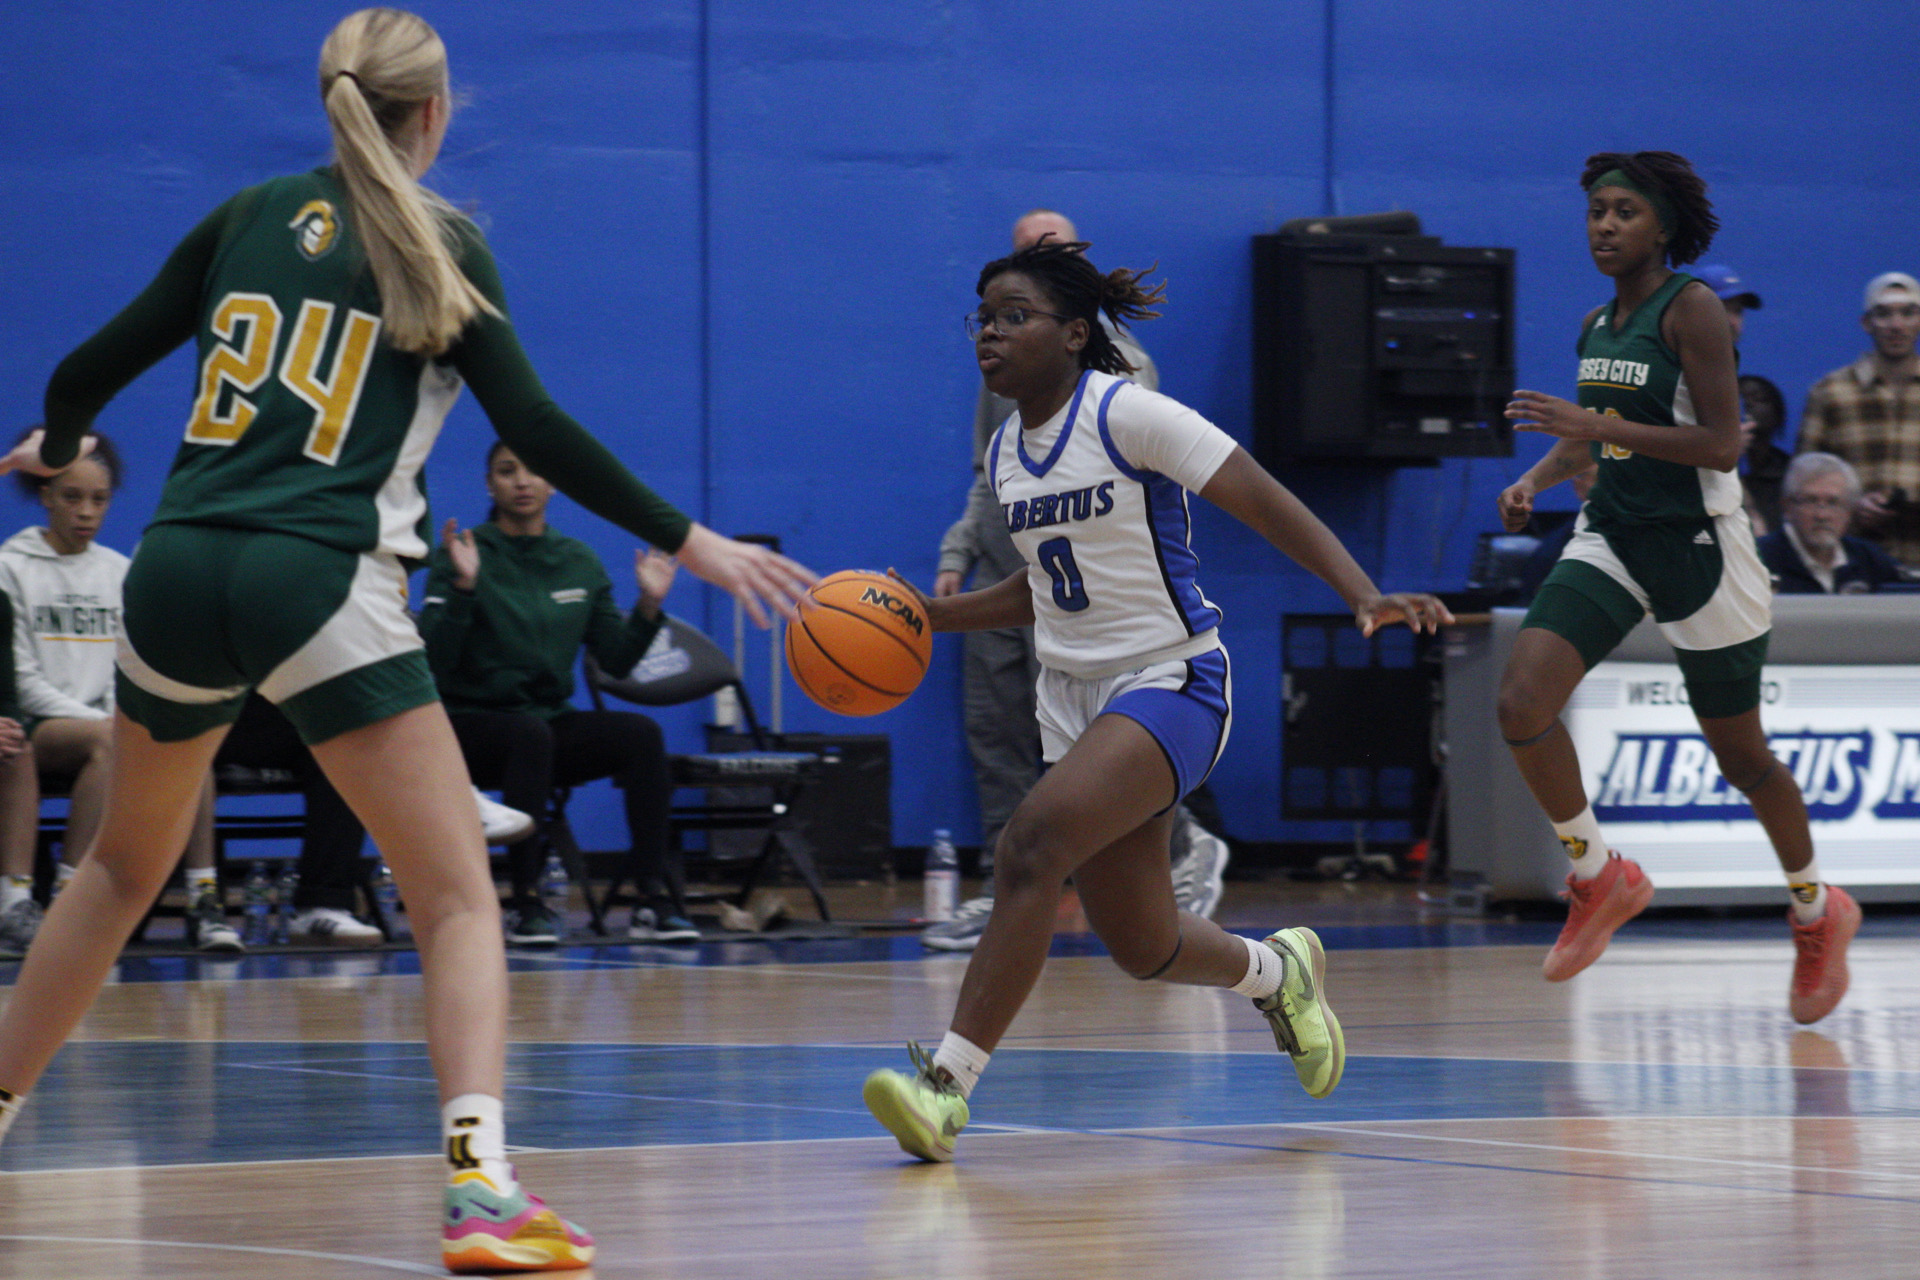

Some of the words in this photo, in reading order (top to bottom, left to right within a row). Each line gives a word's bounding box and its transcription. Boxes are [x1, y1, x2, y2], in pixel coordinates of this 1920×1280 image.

[184, 292, 382, 466] 24
[1610, 359, 1650, 387] CITY
[1001, 480, 1114, 534] LBERTUS
[1037, 536, 1090, 612] 0
[859, 586, 923, 637] NCAA
[1627, 681, 1691, 705] WELC
[1598, 736, 1864, 807] ALBETUS
